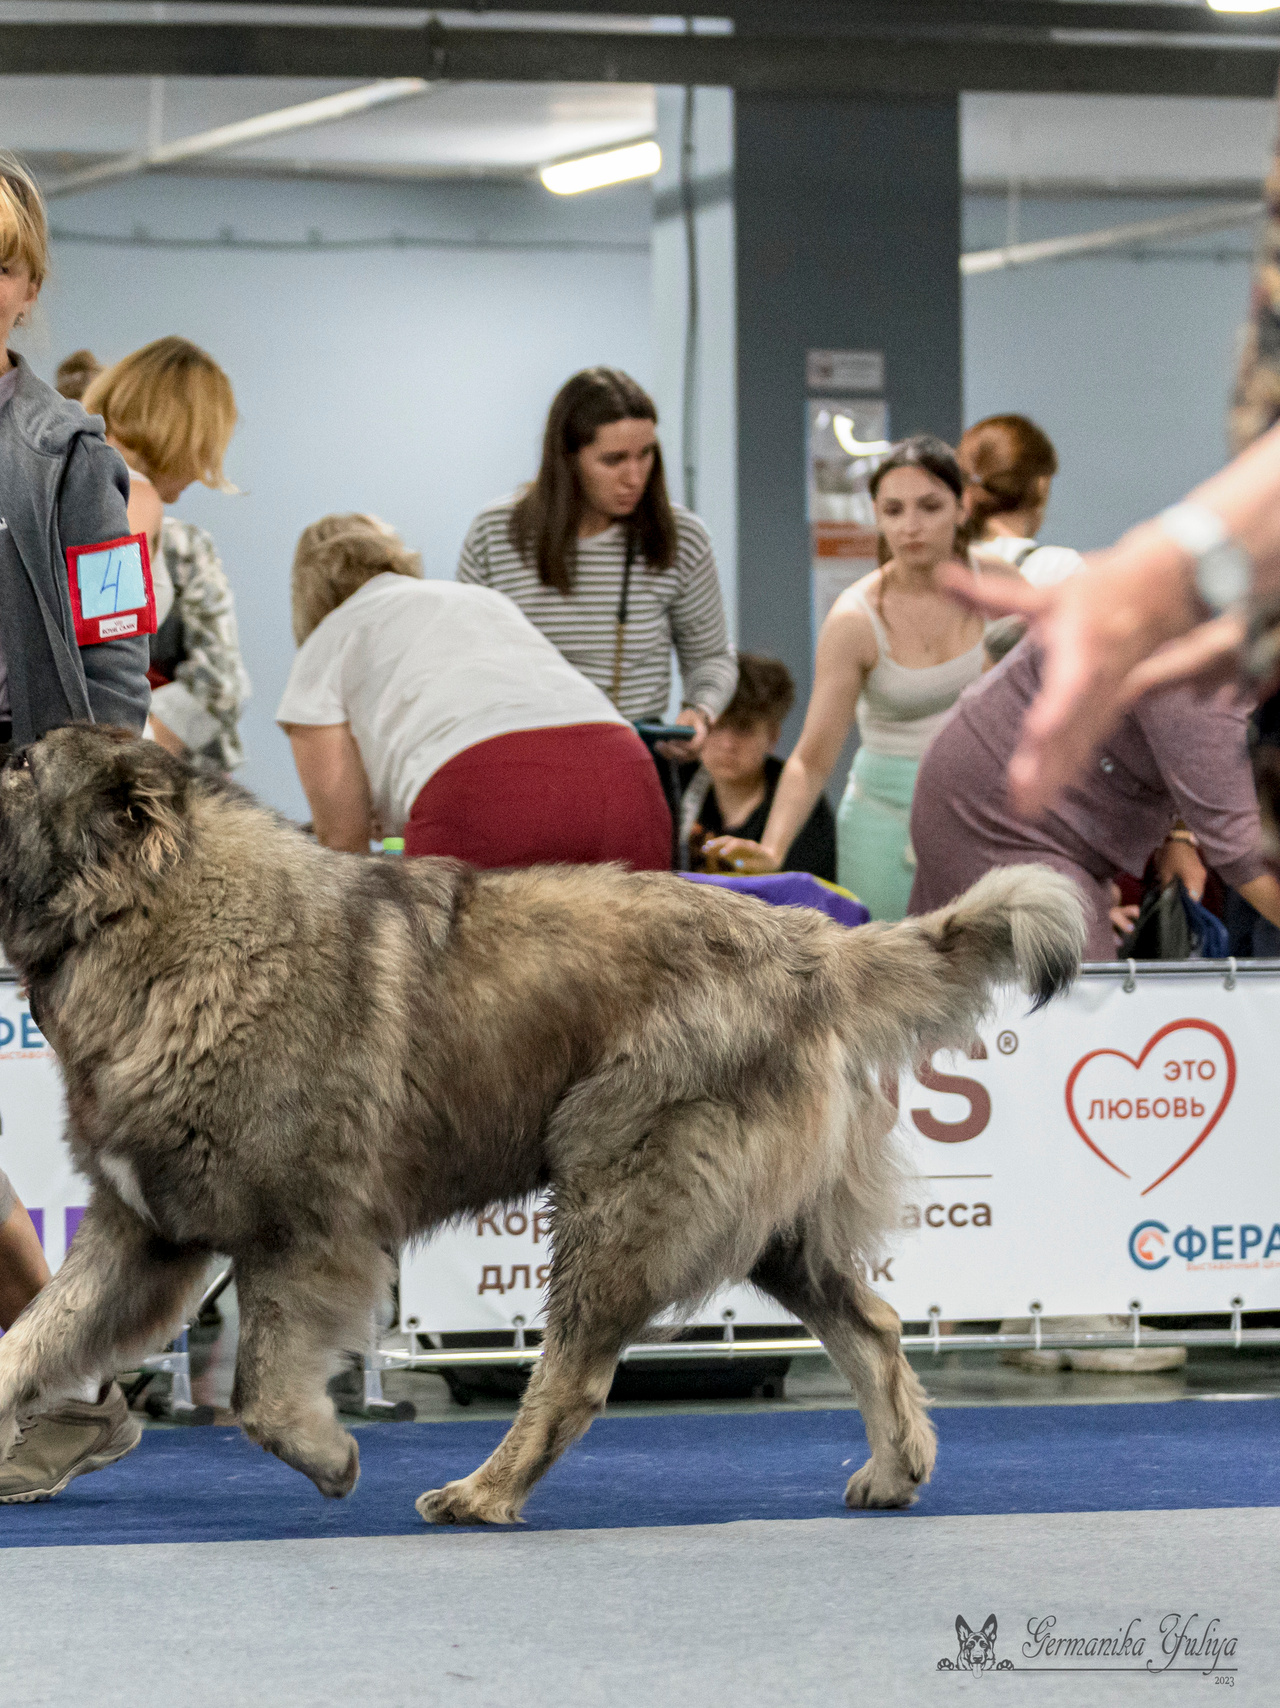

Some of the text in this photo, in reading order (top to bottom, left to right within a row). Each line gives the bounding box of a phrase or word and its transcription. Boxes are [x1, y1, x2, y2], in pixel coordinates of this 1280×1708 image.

[99, 550, 122, 613] 4
[1163, 1059, 1216, 1081] ЭТО
[1087, 1096, 1206, 1120] ЛЮБОВЬ
[477, 1264, 552, 1295] для
